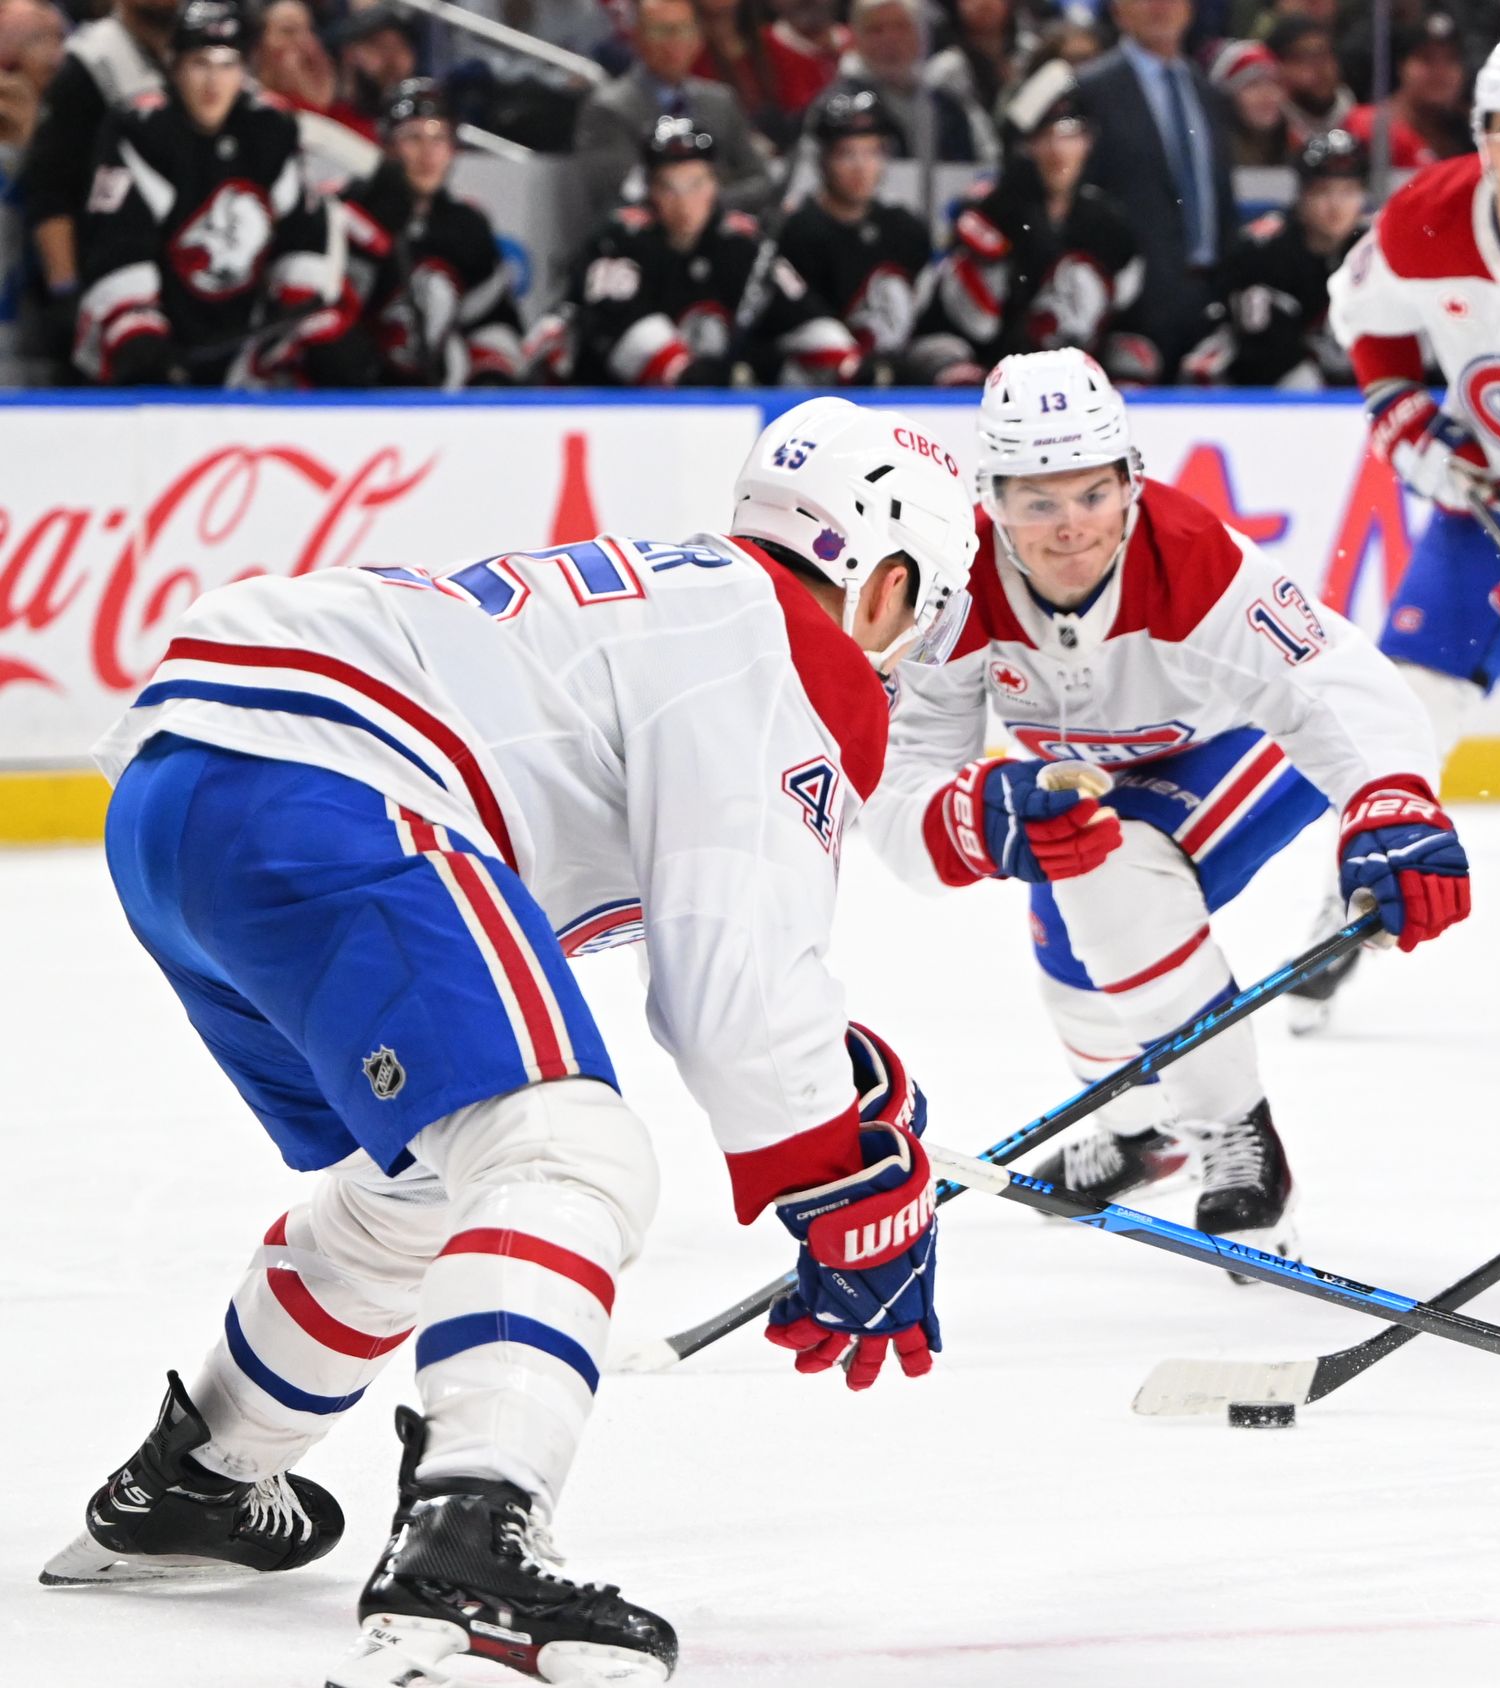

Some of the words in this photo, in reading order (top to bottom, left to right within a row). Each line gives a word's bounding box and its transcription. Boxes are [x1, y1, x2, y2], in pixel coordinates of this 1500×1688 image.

[1040, 391, 1068, 414] 13
[774, 437, 818, 470] 45
[893, 427, 944, 466] CIBC
[1033, 433, 1082, 447] BAUER
[781, 754, 843, 872] 4
[953, 757, 992, 860] BAU
[1340, 798, 1437, 837] UER
[1229, 1242, 1303, 1274] ALPHA
[120, 1467, 155, 1506] 45
